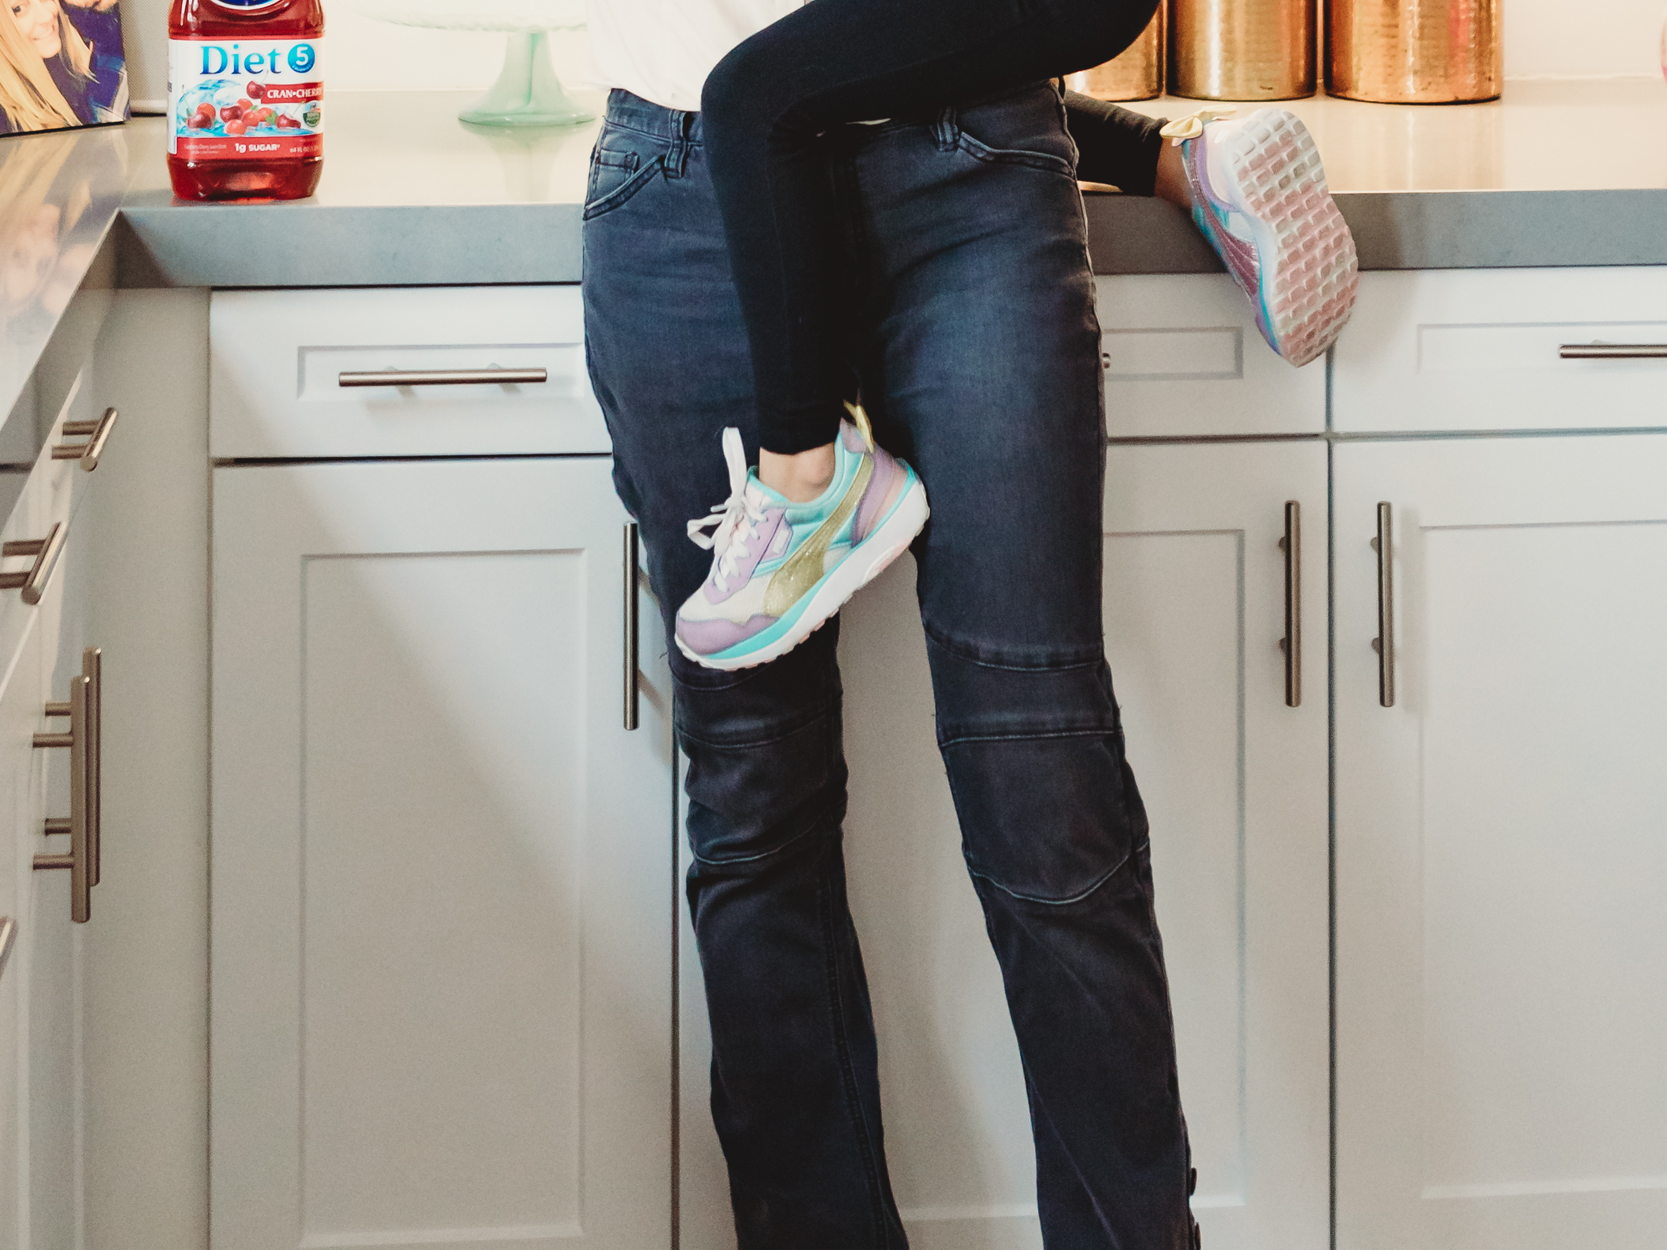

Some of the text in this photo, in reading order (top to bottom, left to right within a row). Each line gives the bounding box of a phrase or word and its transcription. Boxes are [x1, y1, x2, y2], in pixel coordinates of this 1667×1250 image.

[200, 44, 309, 75] Diet 5
[235, 143, 247, 153] 1g
